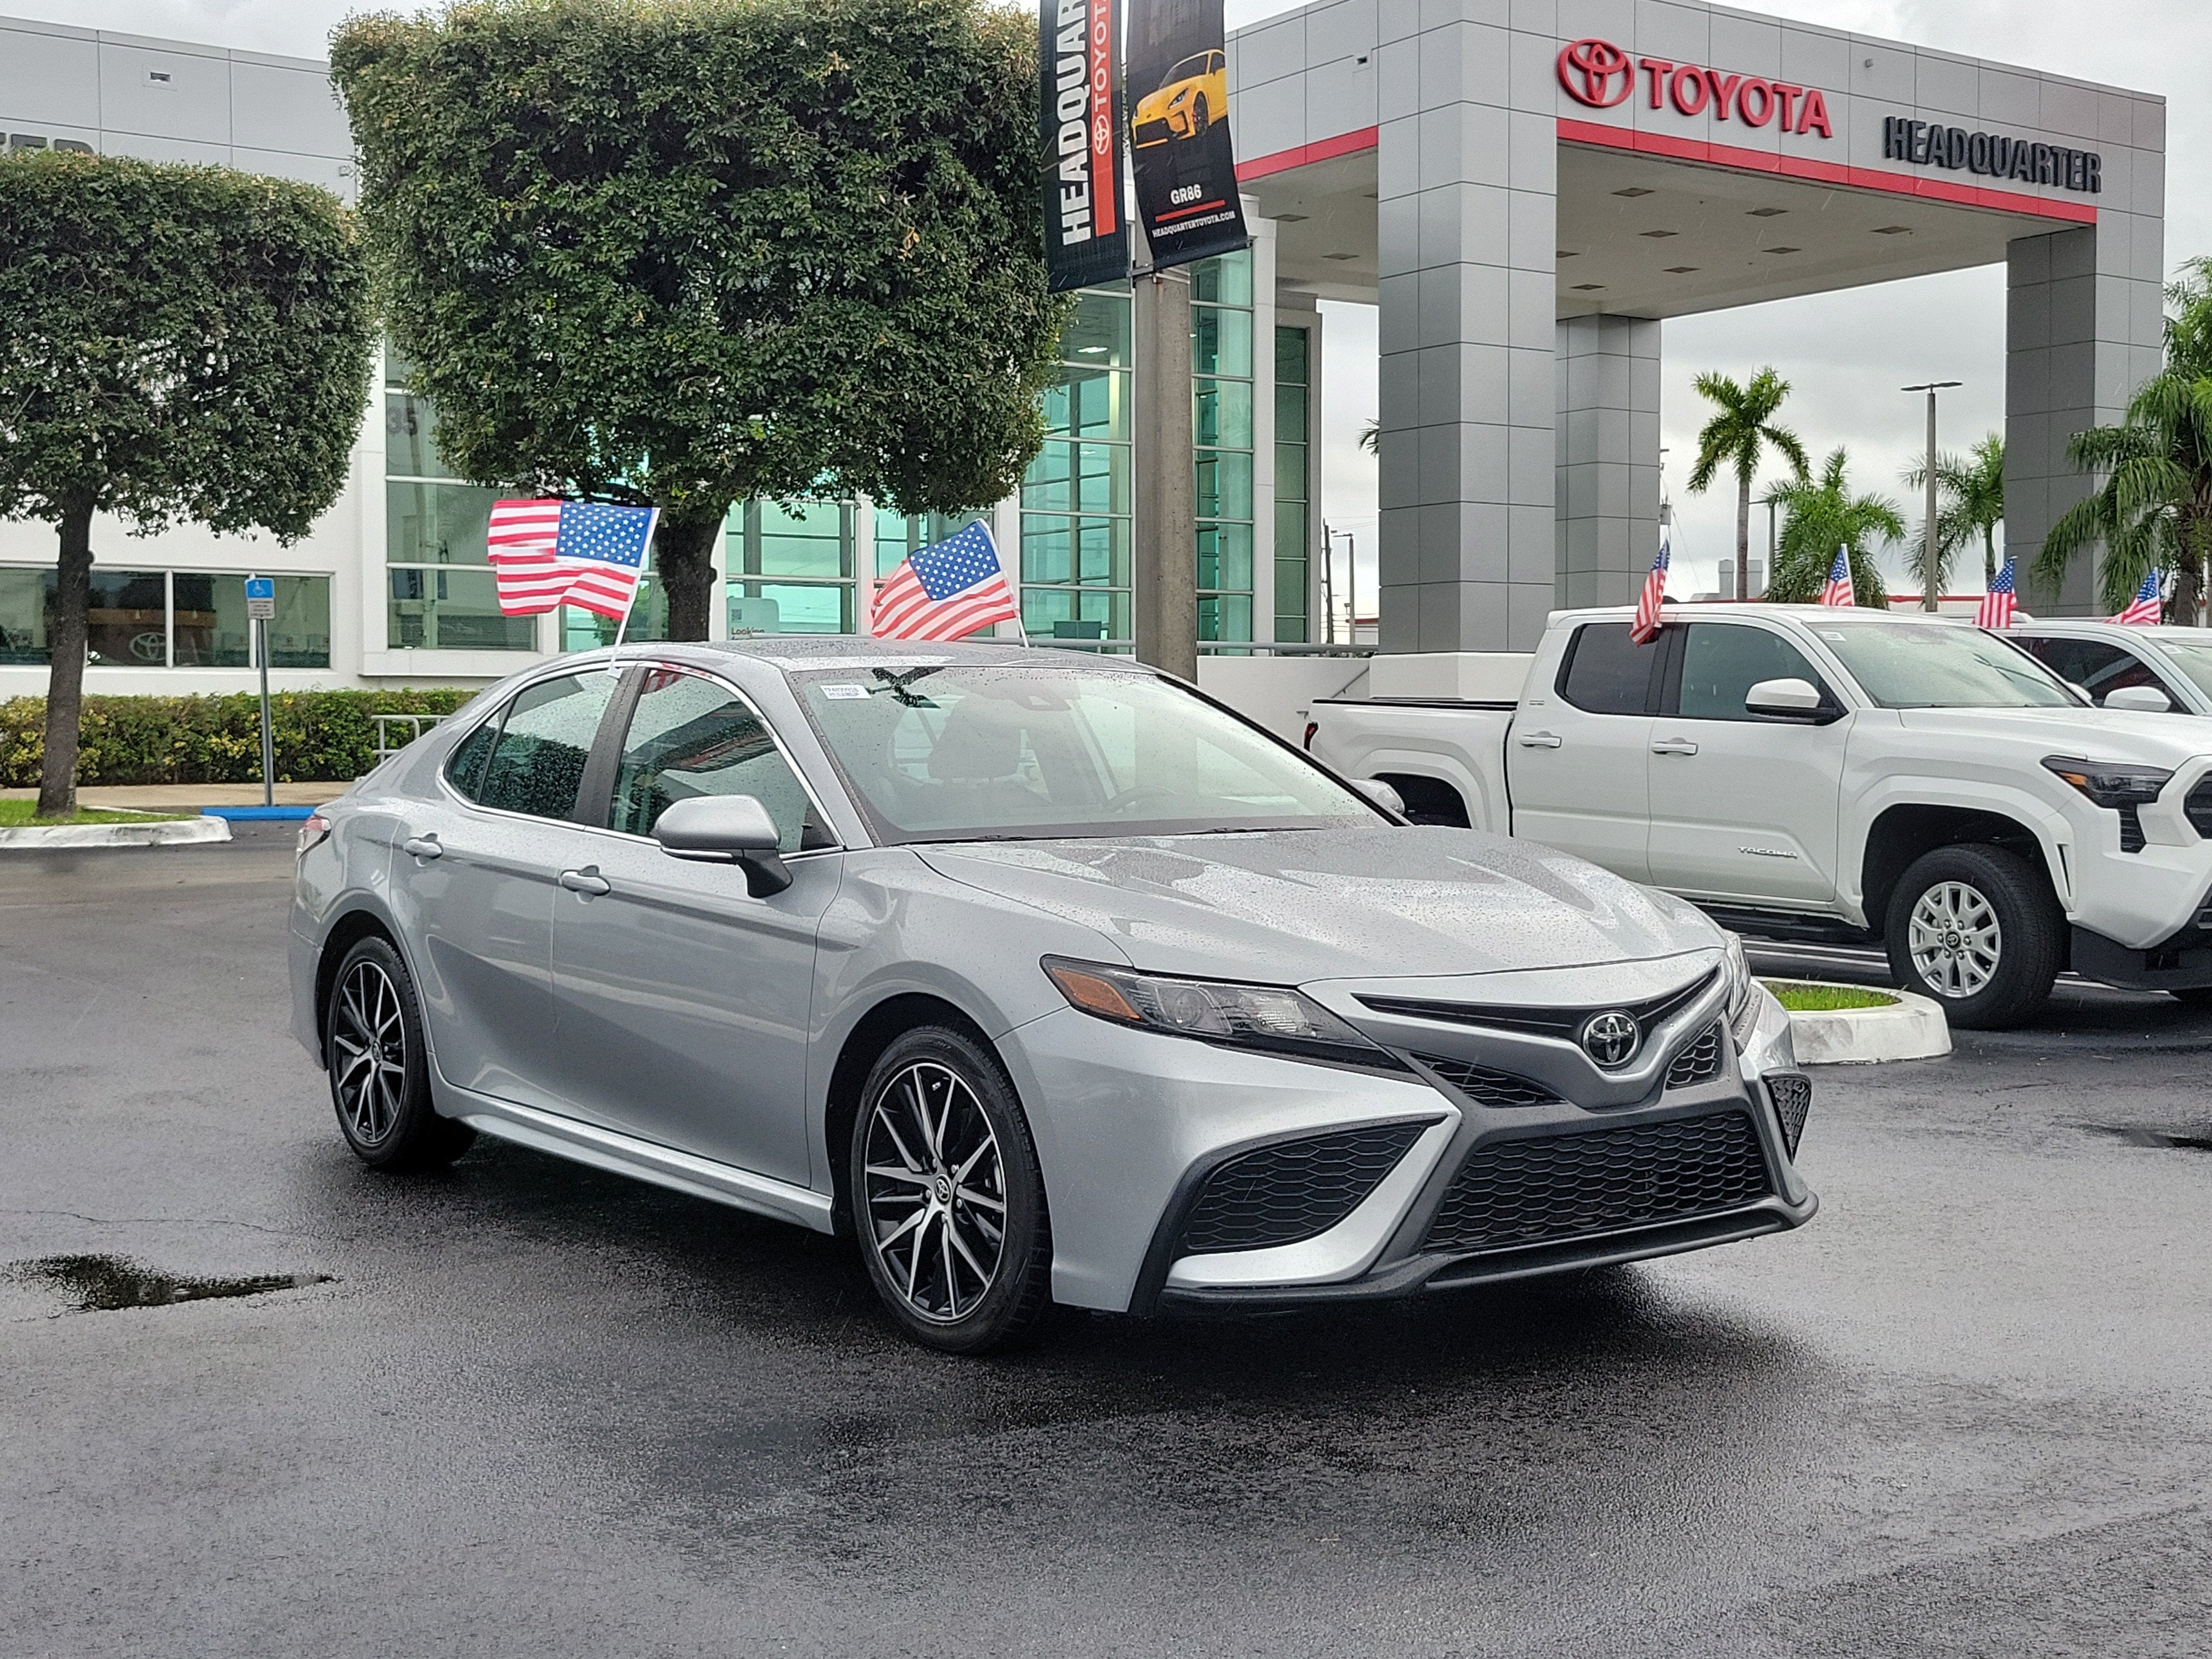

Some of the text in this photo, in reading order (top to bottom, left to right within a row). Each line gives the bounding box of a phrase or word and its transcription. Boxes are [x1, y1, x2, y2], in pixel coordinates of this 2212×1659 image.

[1094, 0, 1107, 112] TOYOT
[1640, 58, 1832, 138] TOYOTA
[1884, 116, 2101, 193] HEADQUARTER
[1170, 184, 1202, 205] GR86
[1152, 211, 1235, 238] HEADQUARTERTOYOTA.COM
[1737, 847, 1798, 859] TACOMA
